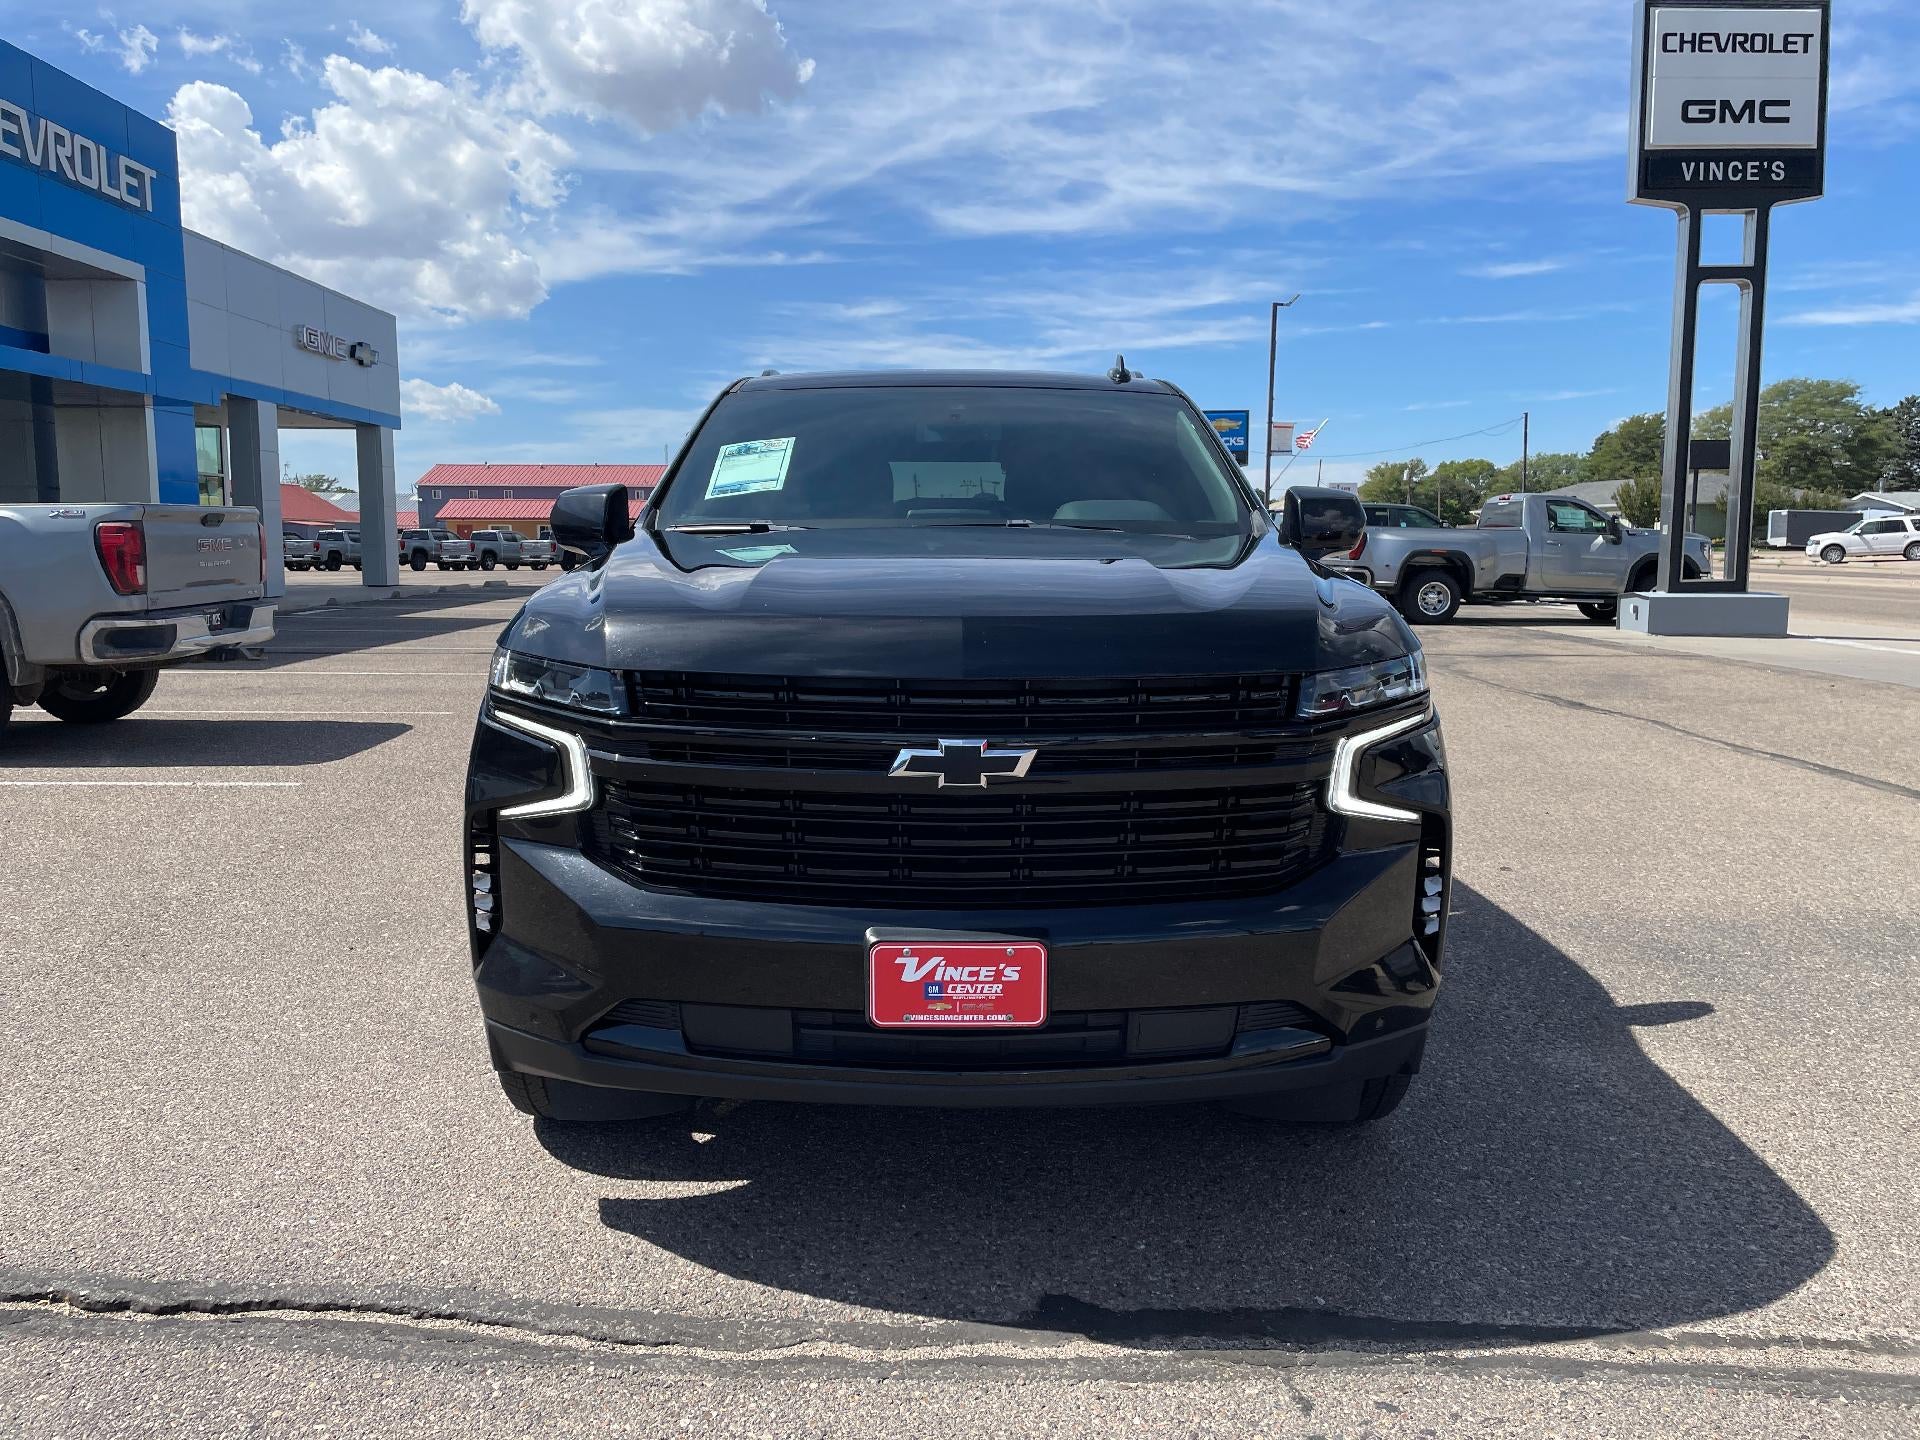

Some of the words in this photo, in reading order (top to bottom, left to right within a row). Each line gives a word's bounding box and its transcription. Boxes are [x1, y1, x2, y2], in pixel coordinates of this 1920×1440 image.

[1662, 32, 1815, 54] CHEVROLET
[1680, 99, 1791, 124] GMC
[1681, 160, 1785, 182] VINCE'S
[302, 324, 348, 361] GMC
[197, 537, 233, 552] GMC
[947, 983, 1003, 994] CENTER
